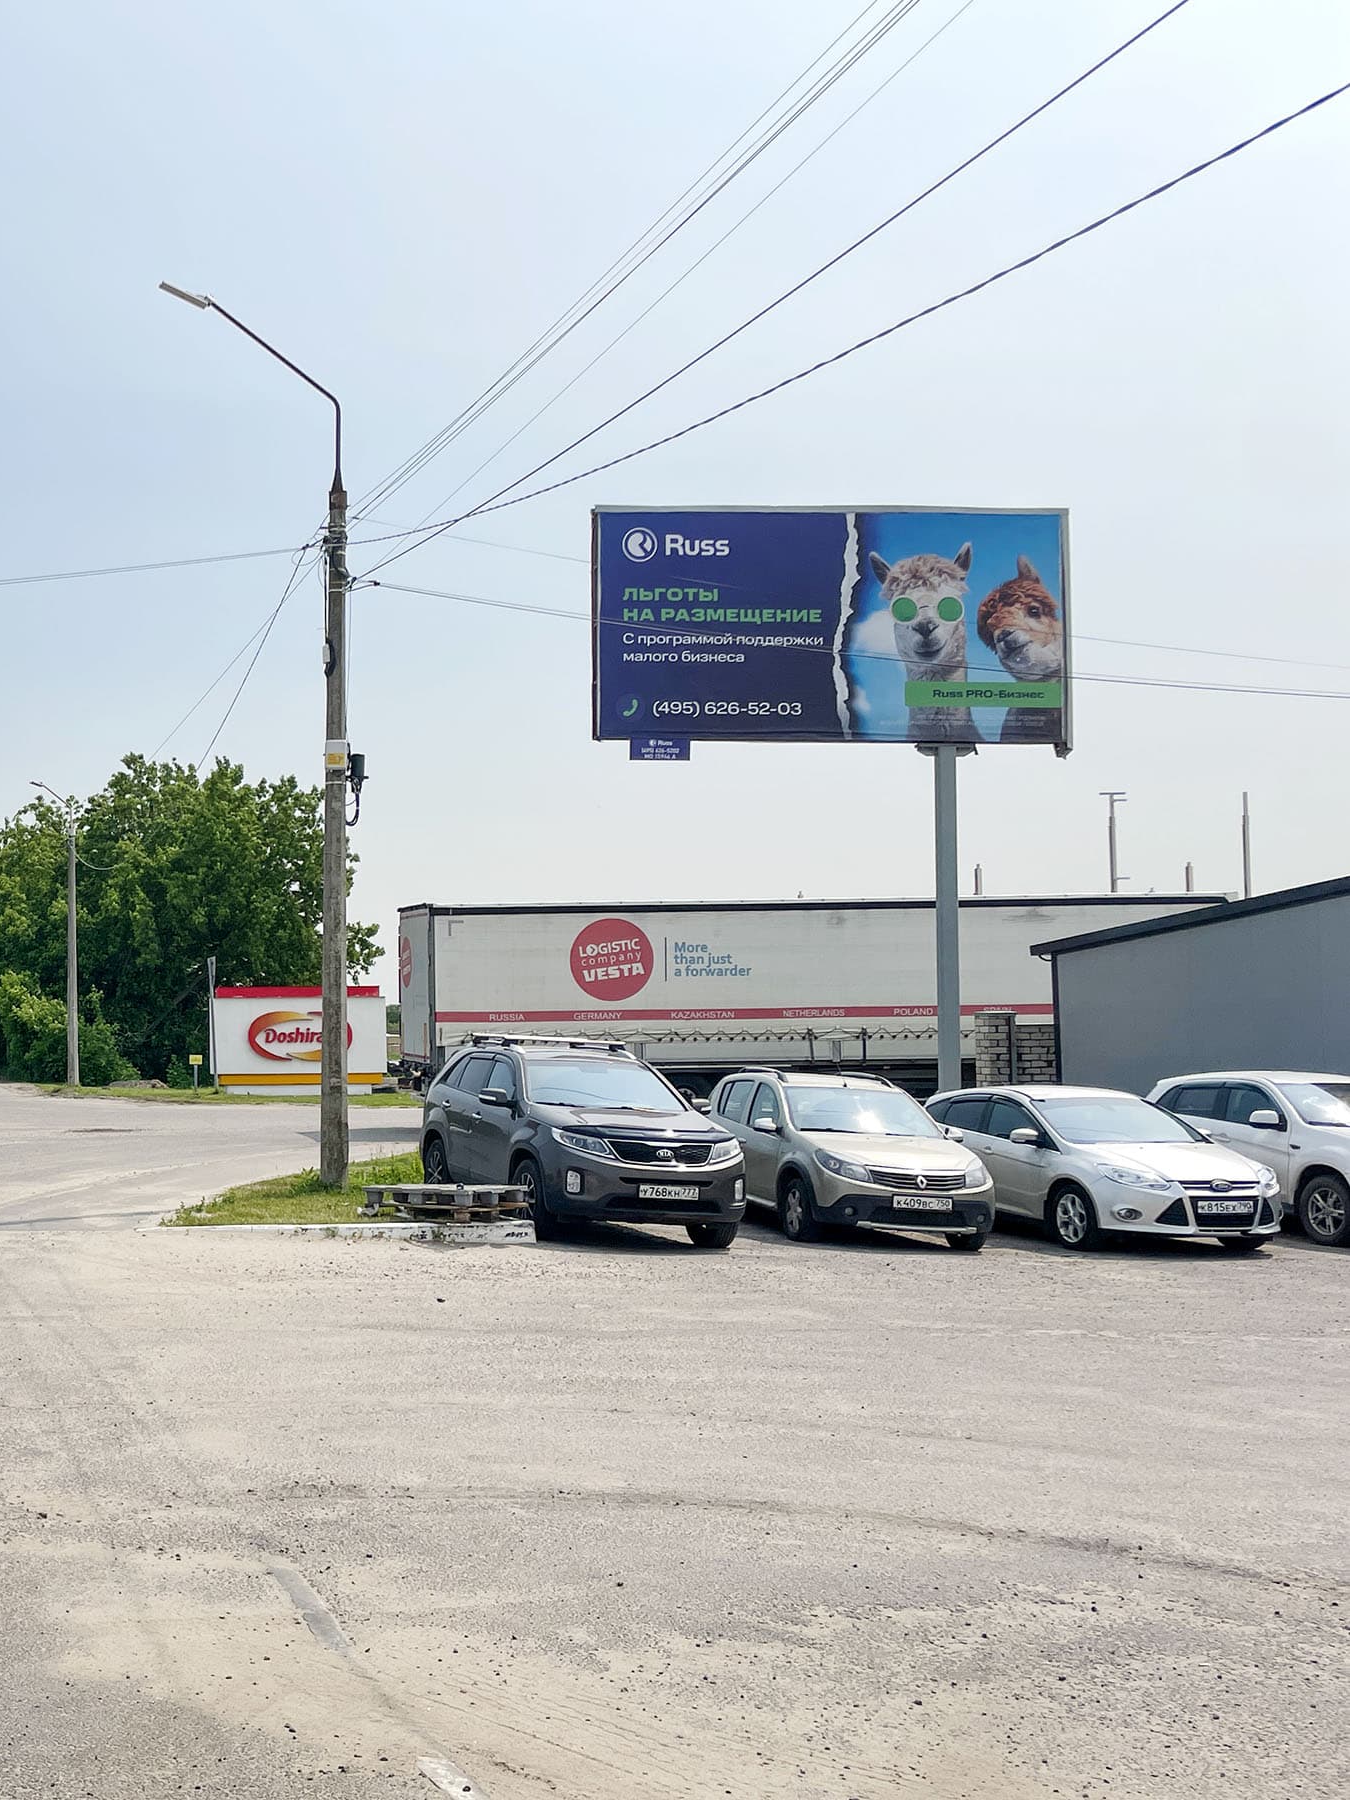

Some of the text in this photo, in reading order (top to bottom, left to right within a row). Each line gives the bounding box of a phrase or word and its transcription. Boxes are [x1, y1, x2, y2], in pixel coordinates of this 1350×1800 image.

[664, 534, 730, 556] Russ
[622, 587, 719, 601] ЛЬГОТЫ
[622, 608, 822, 624] НА РАЗМЕЩЕНИЕ
[622, 632, 824, 647] С программой поддержки
[622, 650, 745, 664] малого бизнеса
[932, 689, 1045, 699] Russ PRO-Бизнес
[652, 701, 802, 718] (495) 626-52-03
[578, 938, 641, 958] LOGISTIC
[674, 941, 708, 953] More
[581, 950, 642, 967] company
[673, 953, 733, 968] than just
[582, 962, 646, 983] VESTA
[674, 964, 752, 977] a forwarder
[488, 1013, 525, 1022] RUSSIA
[573, 1012, 622, 1021] GERMANY
[670, 1010, 735, 1019] KAZAKHSTAN
[782, 1008, 846, 1018] NETHERLANDS
[893, 1007, 934, 1016] POLAND
[264, 1026, 322, 1044] Doshira
